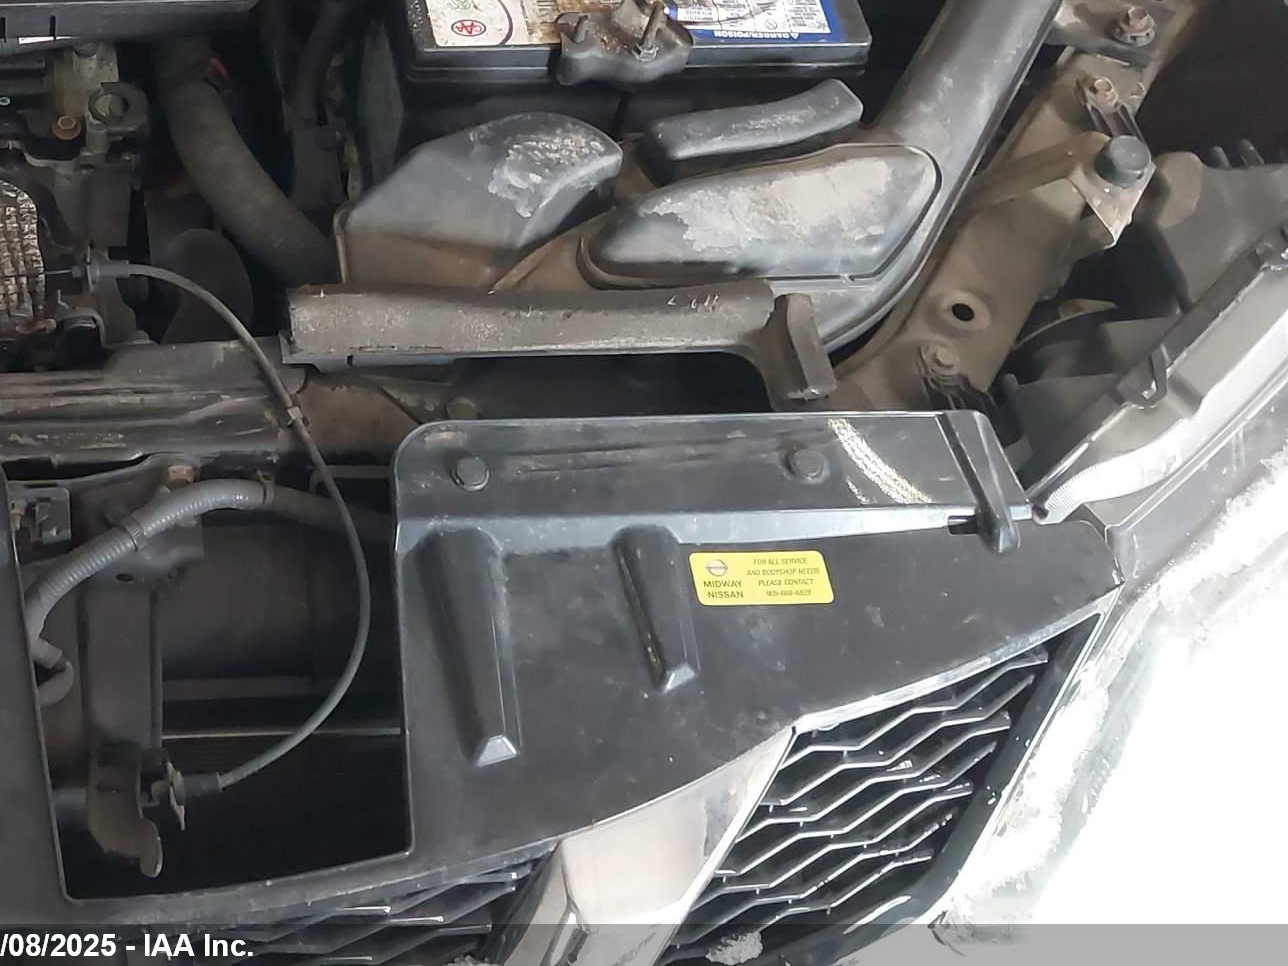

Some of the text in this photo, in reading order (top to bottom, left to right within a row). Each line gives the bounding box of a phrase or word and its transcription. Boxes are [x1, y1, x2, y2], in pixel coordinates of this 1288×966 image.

[454, 21, 484, 35] CAA
[781, 557, 808, 565] SERVICE
[762, 568, 796, 576] BODYSHOP
[798, 567, 820, 575] NEEDS
[703, 580, 743, 588] MIDWAY
[758, 578, 814, 587] PLEASE CONTACT
[707, 590, 744, 599] NISSAN
